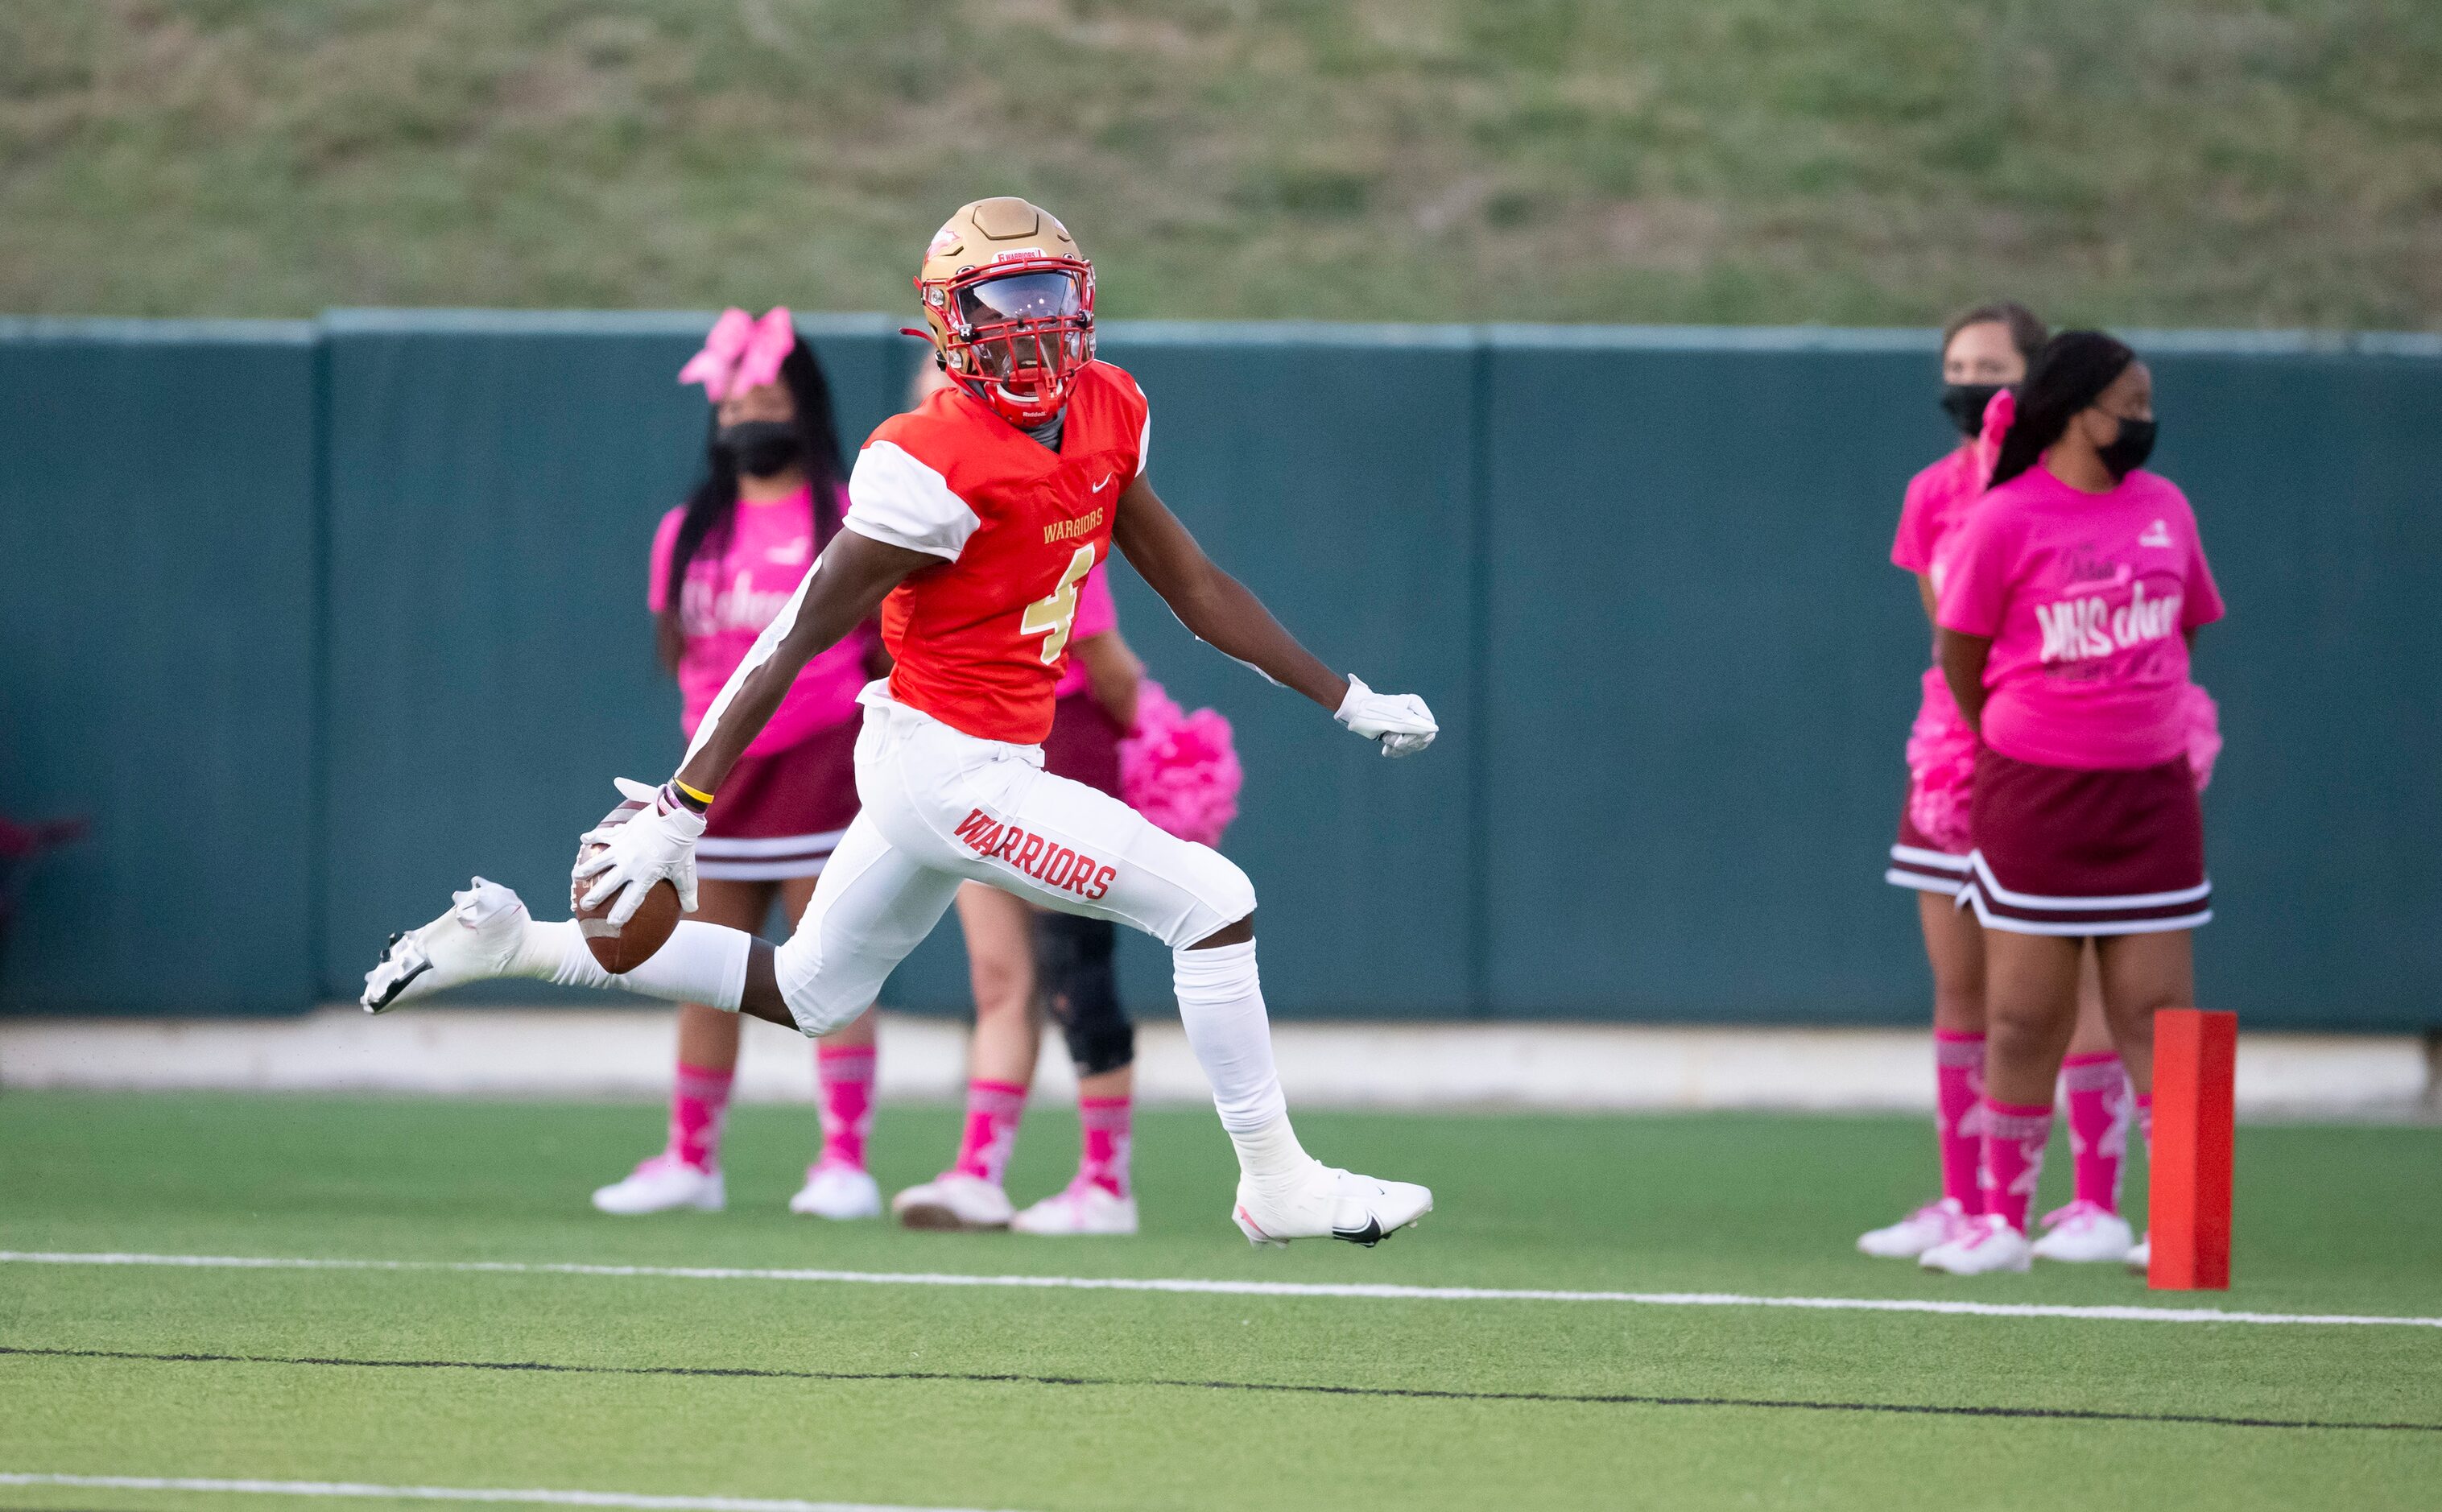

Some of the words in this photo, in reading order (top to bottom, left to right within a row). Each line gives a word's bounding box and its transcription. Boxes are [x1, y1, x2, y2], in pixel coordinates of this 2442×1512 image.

[1043, 507, 1103, 544] WARRIORS
[1020, 542, 1095, 666] 4
[953, 808, 1117, 900] WARRIORS
